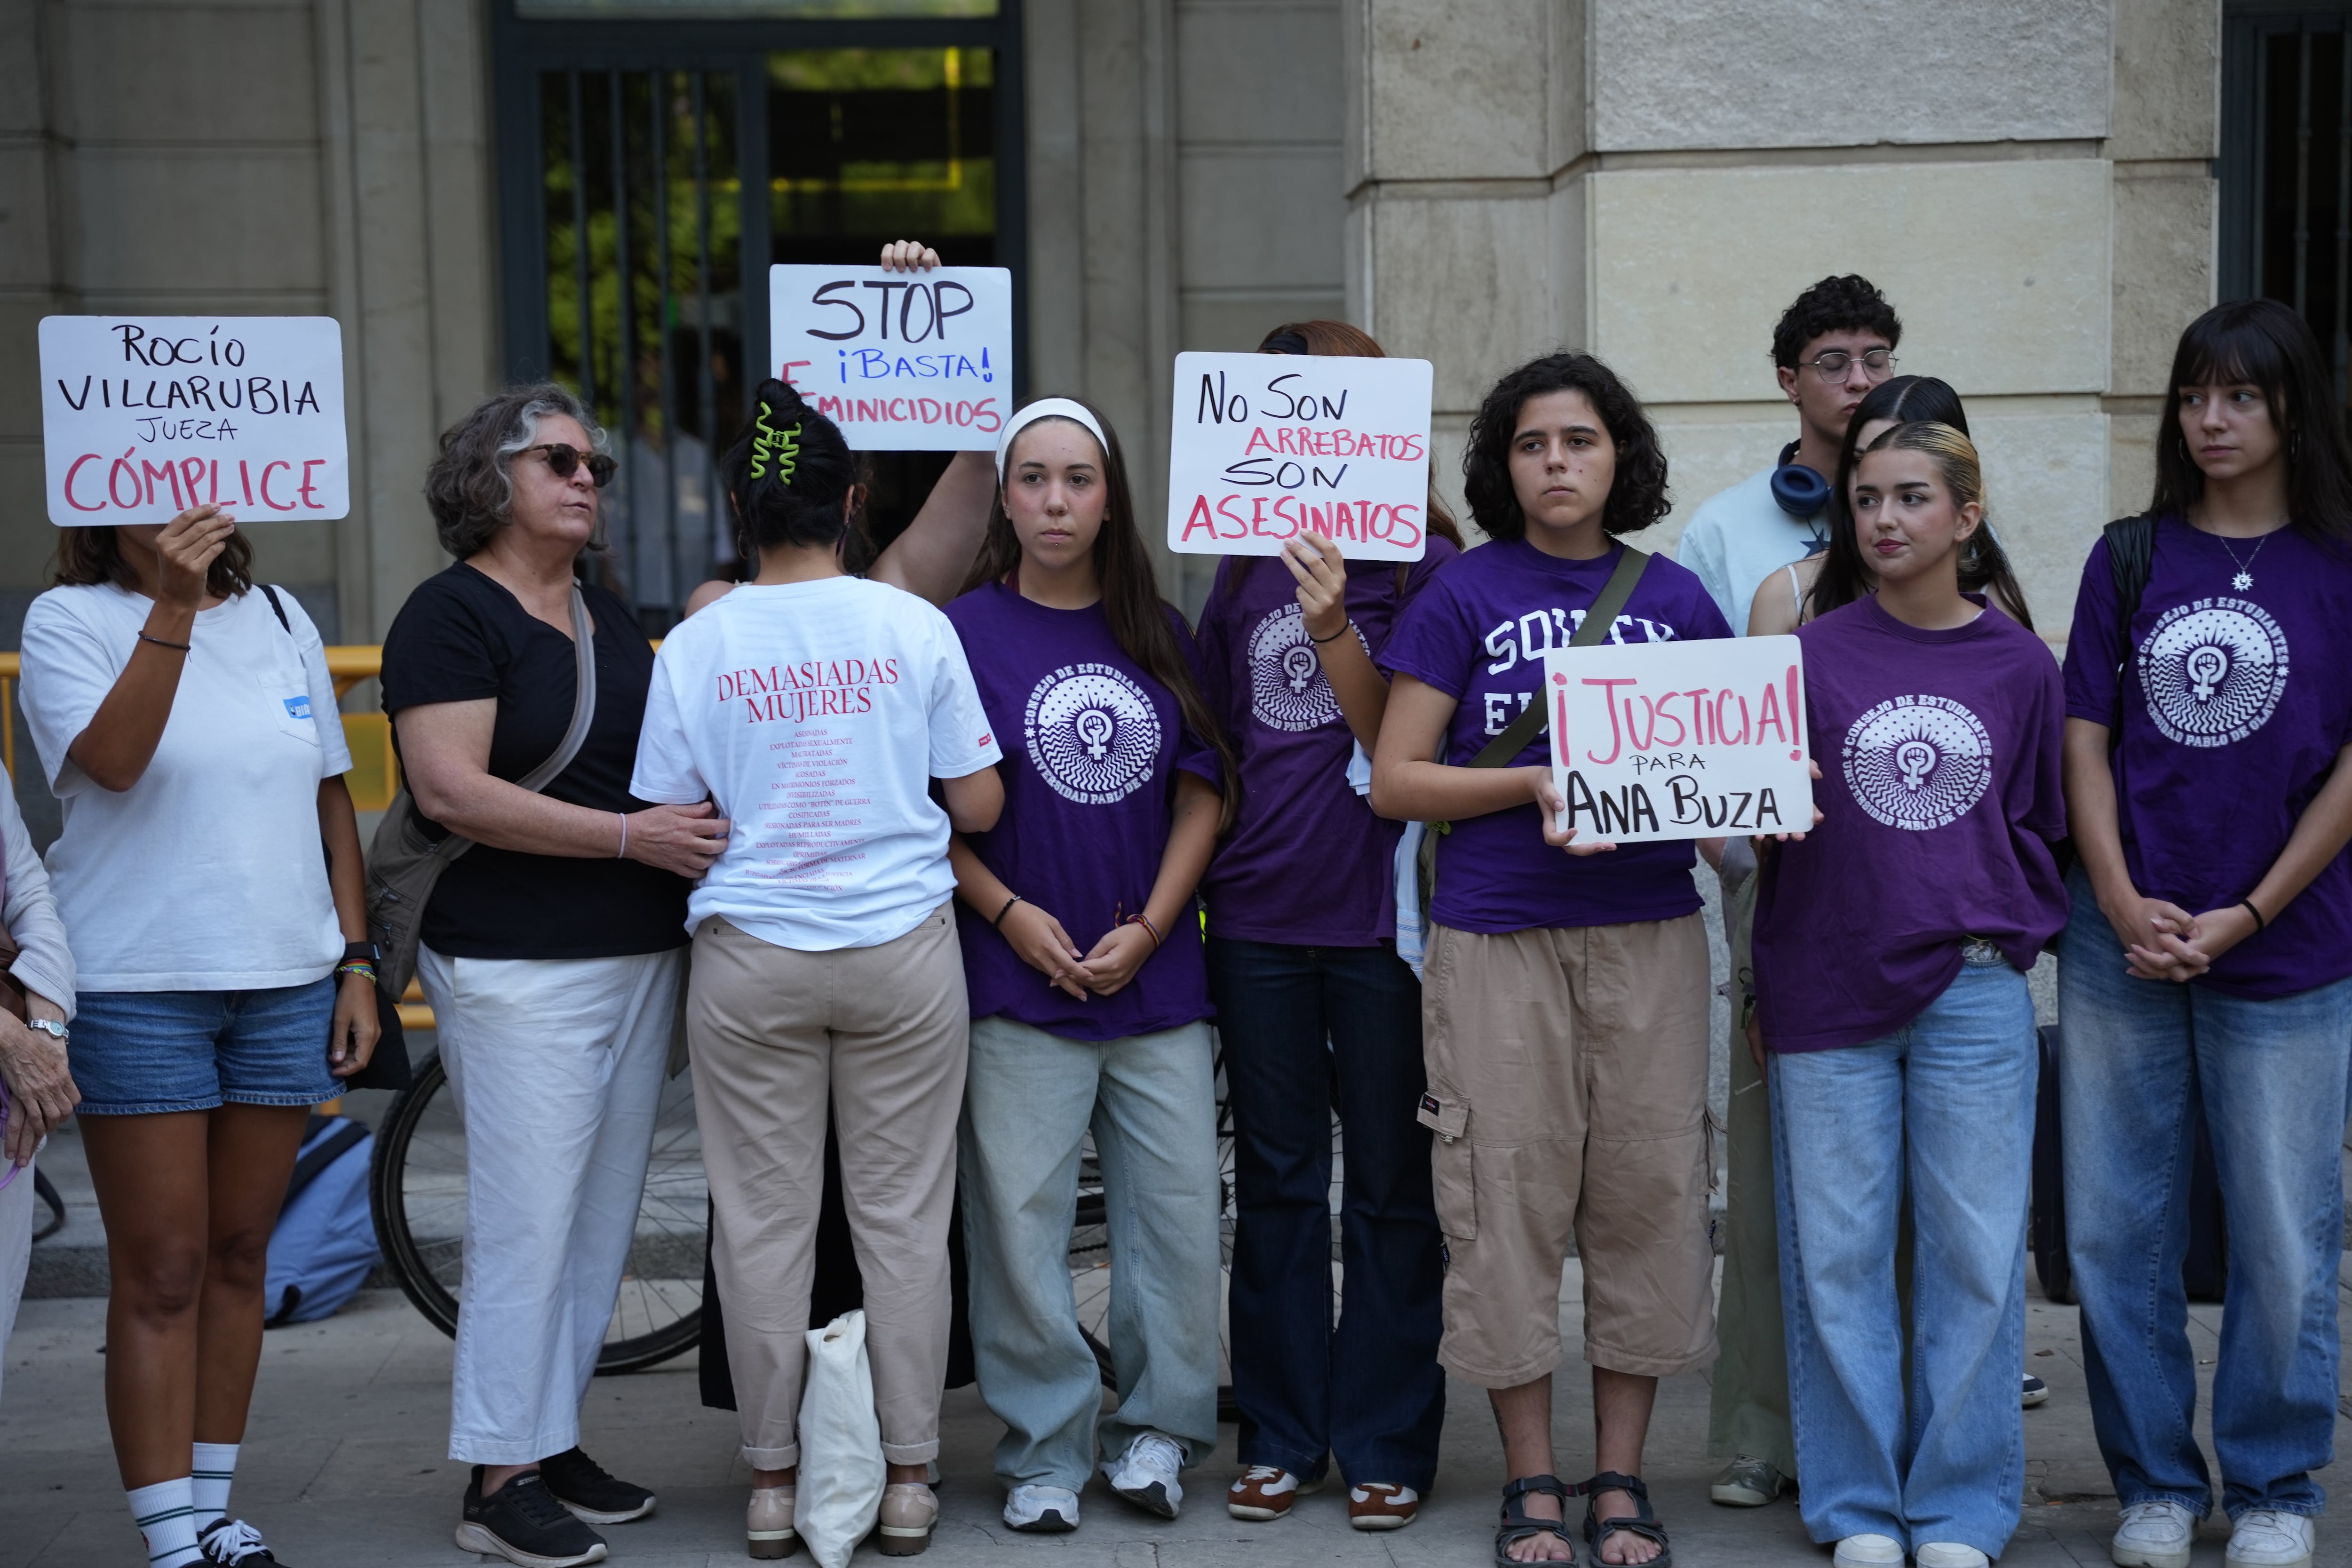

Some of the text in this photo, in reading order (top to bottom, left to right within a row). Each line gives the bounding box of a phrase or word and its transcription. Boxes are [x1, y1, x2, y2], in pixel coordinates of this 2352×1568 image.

[806, 280, 973, 343] STOP
[58, 375, 320, 415] VILLARUBIA
[782, 360, 1001, 432] FMINICIDIOS
[135, 416, 238, 442] JUEZA
[1245, 427, 1423, 461] ARREBATOS
[64, 446, 326, 511] CÓMPLICE
[1220, 458, 1348, 489] SON
[1181, 494, 1421, 548] ASESINATOS
[1248, 603, 1301, 655] CONSEJO DE
[2138, 597, 2289, 664] CONSEJO DE ESTUDIANTES
[716, 658, 898, 702] DEMASIADAS
[745, 686, 872, 723] MUJERES
[1024, 663, 1158, 726] CONSEJO DE ESTUDIANTES
[1283, 718, 1318, 732] PABLO
[1320, 712, 1337, 724] DE
[1552, 665, 1802, 767] ¡JUSTICIA!
[1844, 694, 1992, 756] CONSEJO DE ESTUDIANTES
[2184, 734, 2229, 748] PABLO
[2230, 725, 2251, 742] DE
[2249, 677, 2286, 731] OLAVIDE
[808, 738, 852, 747] SEXUALMENTE
[1026, 738, 1089, 803] UNIVERSIDAD
[1090, 788, 1125, 804] PABLO
[1123, 777, 1143, 794] DE
[1629, 753, 1706, 775] PARA
[1567, 771, 1782, 835] ANA BUZA
[1842, 760, 1992, 831] UNIVERSIDAD PABLO DE OLAVIDE
